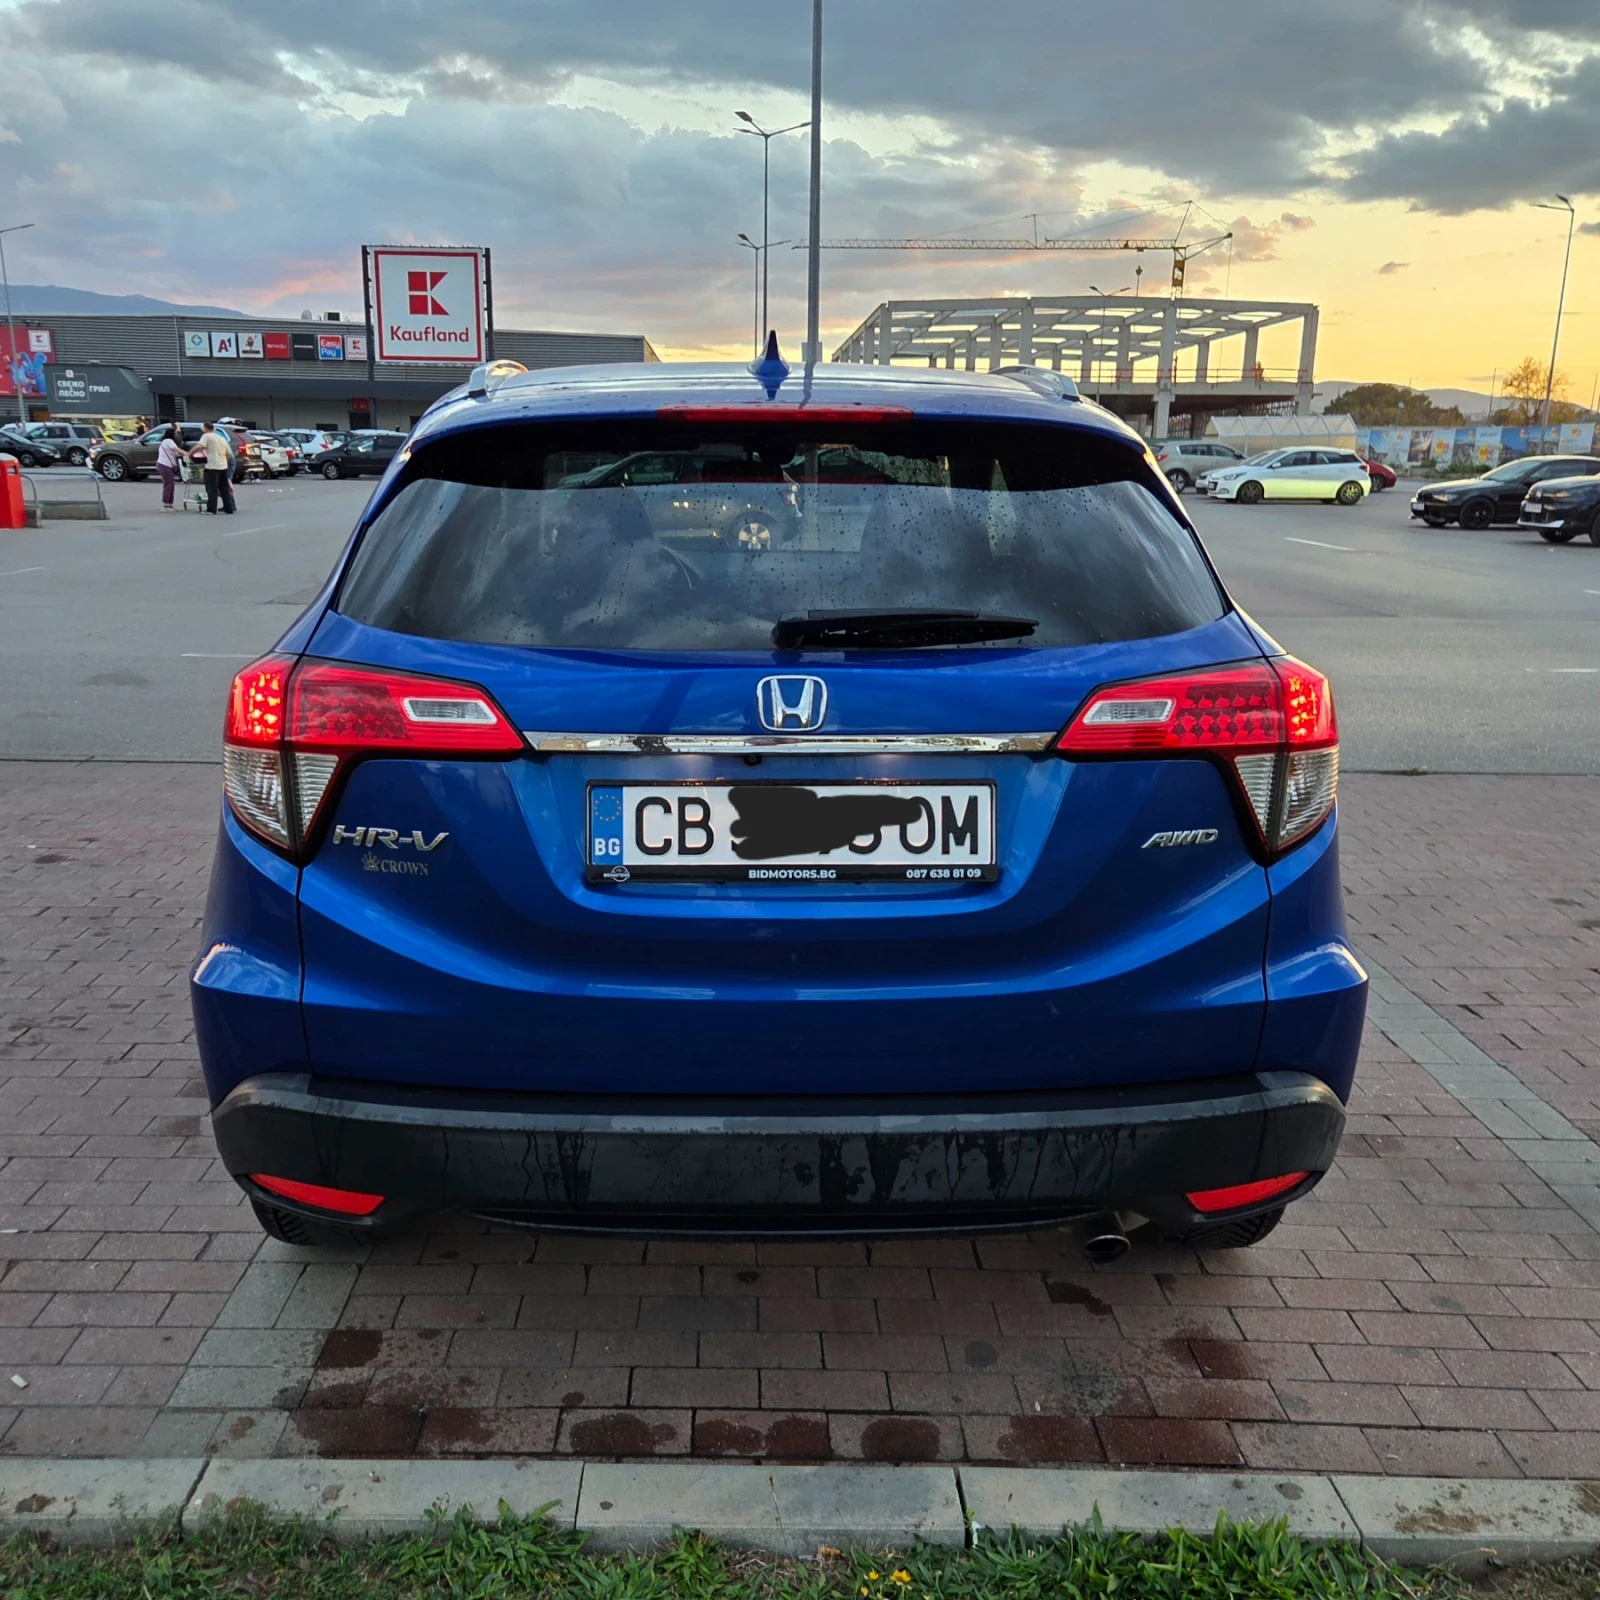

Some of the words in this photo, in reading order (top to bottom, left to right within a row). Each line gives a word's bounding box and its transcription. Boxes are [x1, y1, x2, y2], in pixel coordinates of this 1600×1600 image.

[390, 325, 469, 342] Kaufland
[217, 337, 233, 353] A1
[320, 339, 340, 349] Easy
[321, 348, 337, 358] Pay
[88, 385, 111, 393] ГРИЛ
[634, 796, 715, 856] CB
[333, 825, 450, 851] HR-V
[1141, 828, 1219, 849] AWD
[594, 837, 621, 857] BG
[381, 859, 429, 876] CROWN
[748, 869, 837, 879] BIDMOTORS.BG
[906, 868, 928, 879] 087
[929, 868, 951, 879] 638
[952, 868, 965, 879] 81
[966, 868, 982, 879] 09
